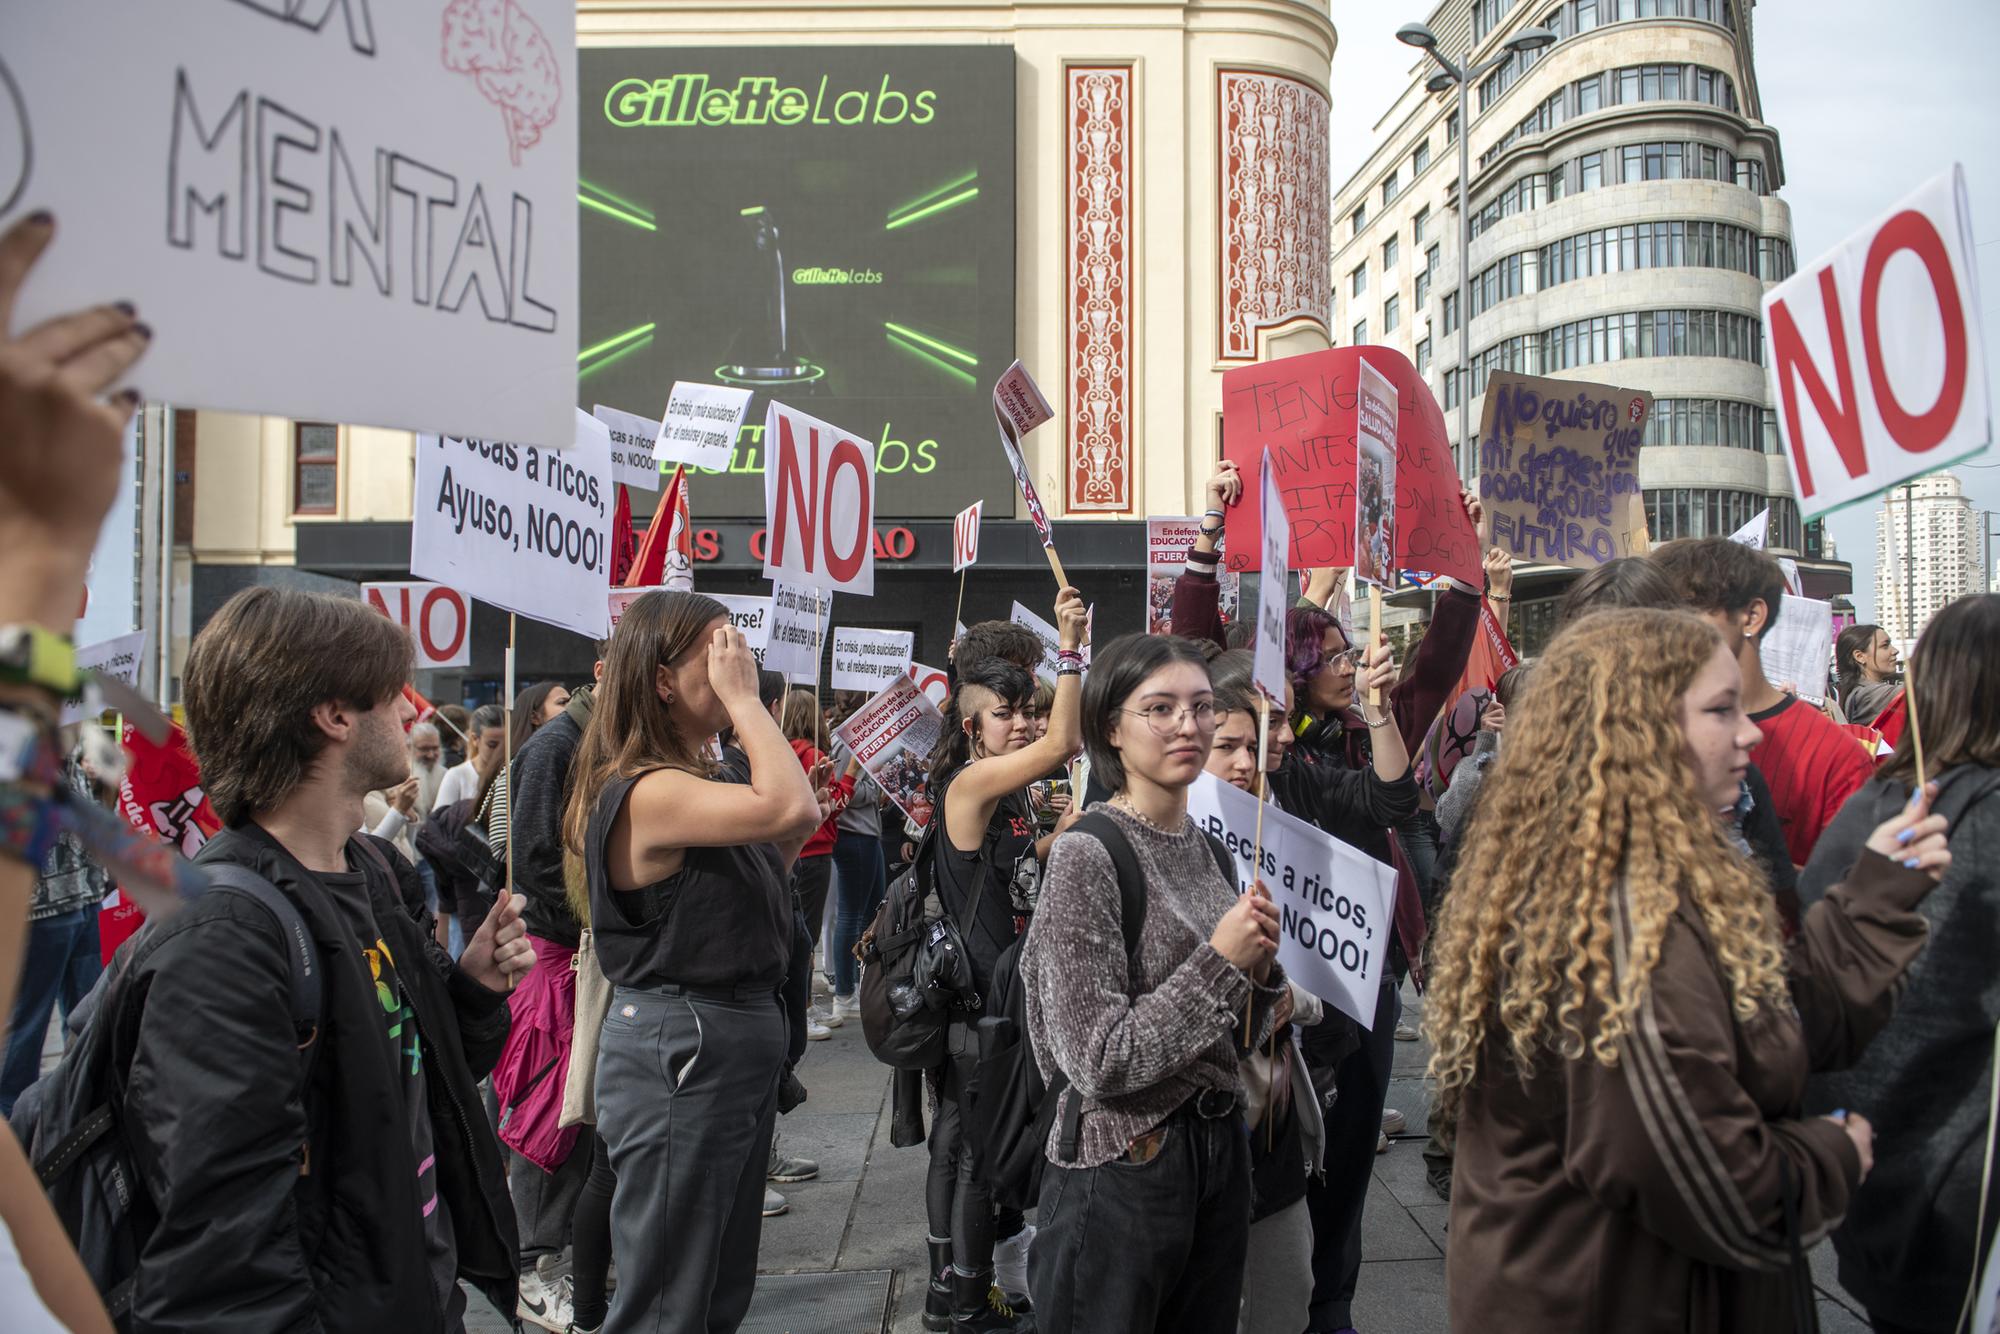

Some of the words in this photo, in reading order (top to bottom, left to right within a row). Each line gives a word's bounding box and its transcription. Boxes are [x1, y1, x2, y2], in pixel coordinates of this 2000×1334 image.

[167, 66, 556, 333] MENTAL
[1768, 209, 1967, 499] NO
[1231, 374, 1357, 432] TENG
[526, 446, 539, 482] a
[547, 448, 604, 519] ricos,
[771, 414, 870, 583] NO
[437, 465, 520, 552] Ayuso,
[527, 503, 604, 575] NOOO!
[954, 507, 977, 569] NO
[1150, 536, 1197, 545] EDUCACIÓ
[1162, 527, 1173, 536] En
[1174, 527, 1200, 536] defens
[836, 639, 844, 652] En
[849, 713, 891, 750] EDUCACIÓN
[889, 688, 921, 716] PÚBLICA
[852, 724, 864, 735] En
[862, 704, 888, 727] defensa
[886, 694, 898, 706] de
[860, 732, 892, 760] ¡FUERA
[890, 708, 920, 736] AYUSO!
[1283, 865, 1295, 892] a
[1302, 874, 1373, 940] ricos,
[1282, 904, 1370, 980] NOOO!
